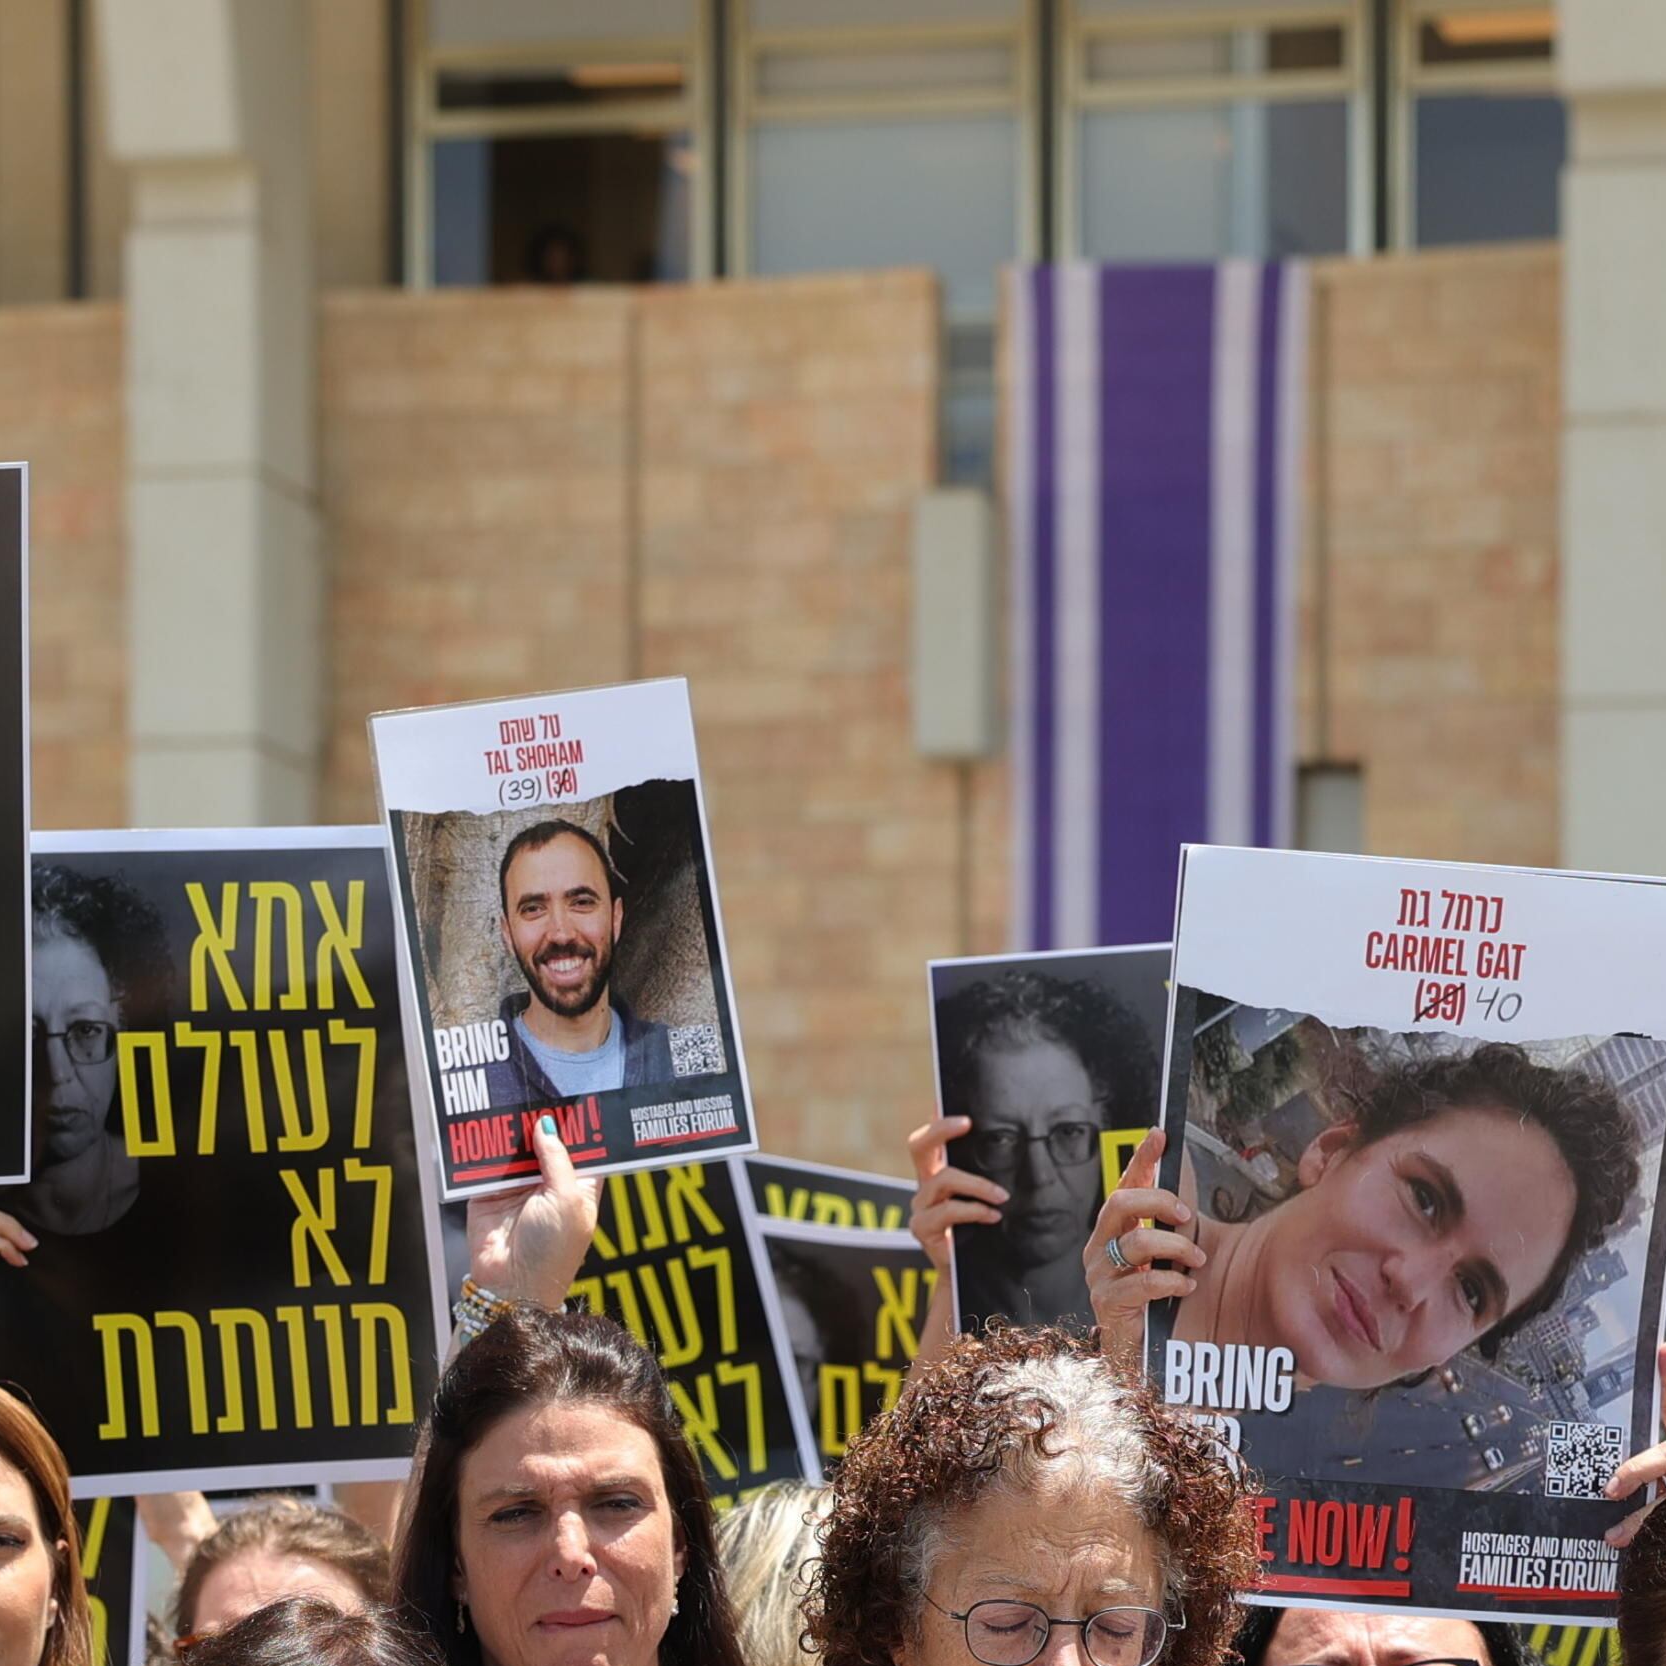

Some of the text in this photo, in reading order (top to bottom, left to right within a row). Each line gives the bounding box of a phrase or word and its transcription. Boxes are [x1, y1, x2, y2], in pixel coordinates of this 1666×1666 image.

[499, 714, 561, 745] טל שהם
[484, 740, 584, 775] TAL SHOHAM
[499, 776, 542, 806] (39)
[1396, 888, 1504, 934] כרמל גת
[186, 880, 375, 1012] אמא
[1365, 933, 1526, 982] CARMEL GAT
[1476, 987, 1523, 1023] 40
[435, 1020, 510, 1070] BRING
[117, 1019, 376, 1158] לעולם
[442, 1068, 491, 1117] HIM
[449, 1096, 604, 1164] HOME NW!
[630, 1105, 674, 1122] HOSTAGES
[633, 1108, 737, 1142] FAMILIES FORUM
[280, 1158, 393, 1289] לא
[93, 1303, 415, 1440] מוותרת
[1164, 1340, 1295, 1413] BRING
[1288, 1497, 1416, 1572] NOW!
[1462, 1532, 1620, 1564] HOSTAGES AND MISSING
[1459, 1554, 1619, 1592] FAMILIES FORUM
